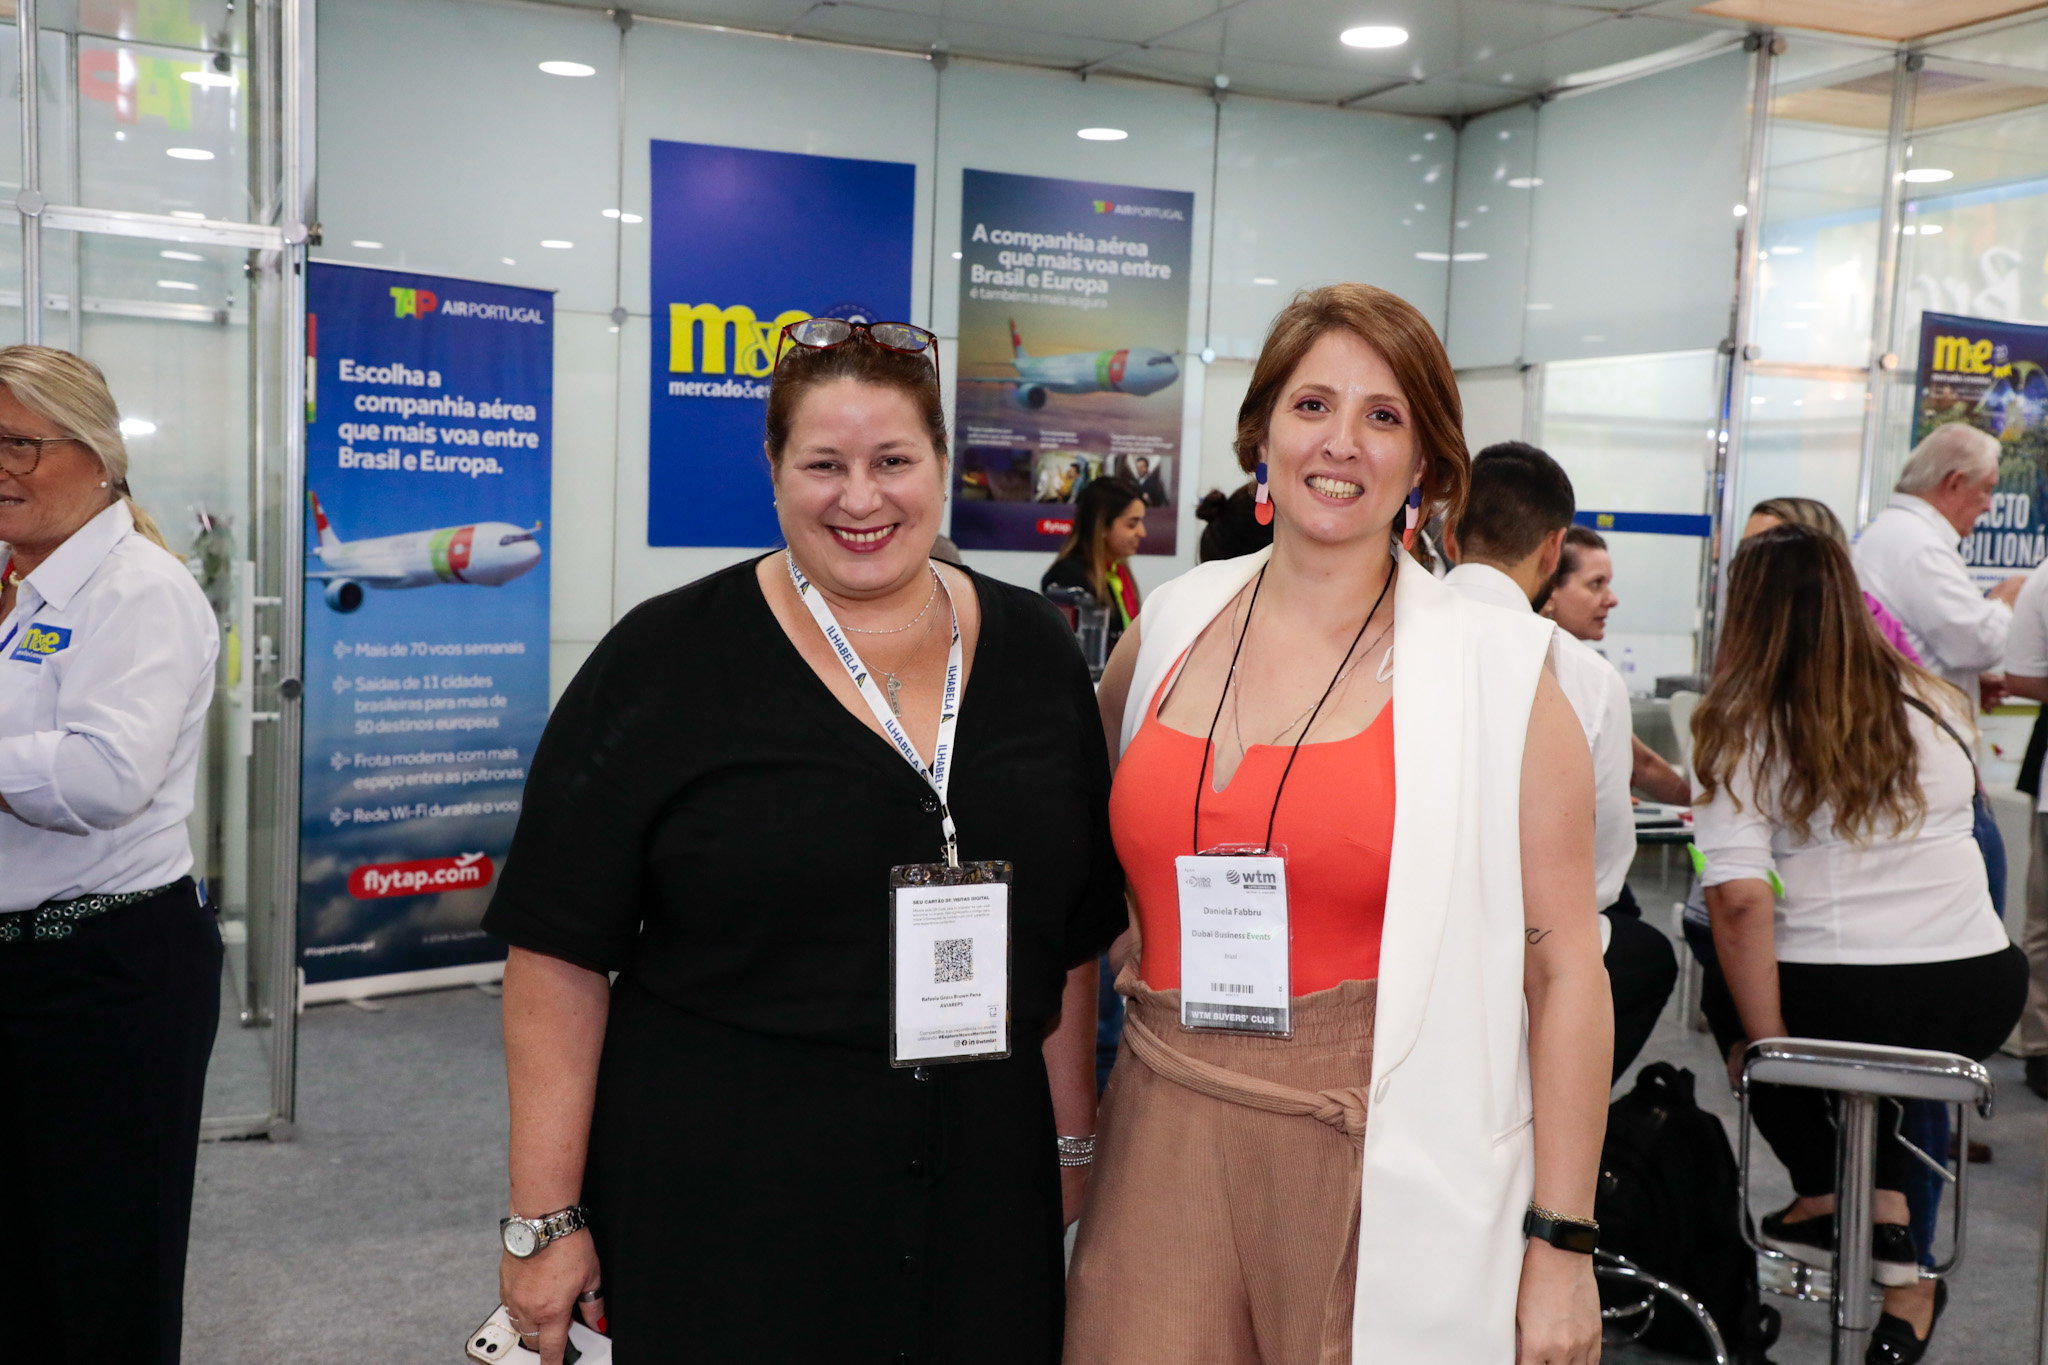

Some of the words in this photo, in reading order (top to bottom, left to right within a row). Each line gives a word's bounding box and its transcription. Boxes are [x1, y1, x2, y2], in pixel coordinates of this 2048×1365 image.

[972, 223, 988, 242] A
[990, 229, 1094, 252] companhia
[1096, 236, 1148, 257] aérea
[998, 250, 1036, 270] que
[1037, 252, 1082, 272] mais
[1084, 259, 1119, 275] voa
[1120, 261, 1171, 279] entre
[971, 264, 1024, 287] Brasil
[1027, 273, 1040, 287] e
[1042, 270, 1109, 295] Europa
[390, 286, 438, 319] TAP
[339, 359, 425, 387] Escolha
[427, 371, 442, 388] a
[354, 394, 475, 419] companhia
[479, 398, 536, 421] aérea
[338, 423, 380, 445] que
[383, 421, 437, 444] mais
[440, 428, 480, 446] voa
[482, 428, 539, 449] entre
[338, 447, 400, 470] Brasil
[403, 454, 417, 471] e
[420, 450, 504, 478] Europa.
[355, 641, 390, 657] Mais
[393, 643, 408, 657] de
[410, 642, 428, 656] 70
[429, 643, 463, 657] voos
[464, 641, 526, 656] semanais
[826, 625, 858, 673] ILHABELA
[403, 676, 420, 690] de
[423, 675, 439, 690] 11
[441, 674, 493, 689] cidades
[944, 665, 957, 711] ILHABELA
[354, 697, 423, 713] brasileiras
[424, 697, 455, 713] para
[456, 694, 488, 710] mais
[490, 694, 507, 708] de
[354, 719, 374, 734] 50
[376, 718, 434, 734] destinos
[435, 716, 499, 731] europeus
[885, 719, 919, 769] ILHABELA
[354, 754, 391, 769] Frota
[392, 751, 455, 766] moderna
[456, 750, 486, 763] com
[487, 746, 518, 761] mais
[354, 774, 404, 791] espaço
[405, 772, 444, 787] entre
[445, 771, 461, 783] as
[462, 768, 524, 785] poltronas
[353, 808, 390, 823] Rede
[391, 803, 428, 820] Wi-Fi
[429, 801, 481, 817] durante
[483, 802, 493, 813] o
[495, 800, 519, 812] voo
[363, 868, 479, 894] flytap.com
[1242, 870, 1276, 884] wtm
[1203, 907, 1232, 916] Daniela
[1191, 930, 1213, 938] Dubai
[1214, 931, 1245, 939] Business
[1246, 932, 1271, 941] Events
[1191, 1011, 1211, 1019] WTM
[1251, 1015, 1275, 1024] CLUB
